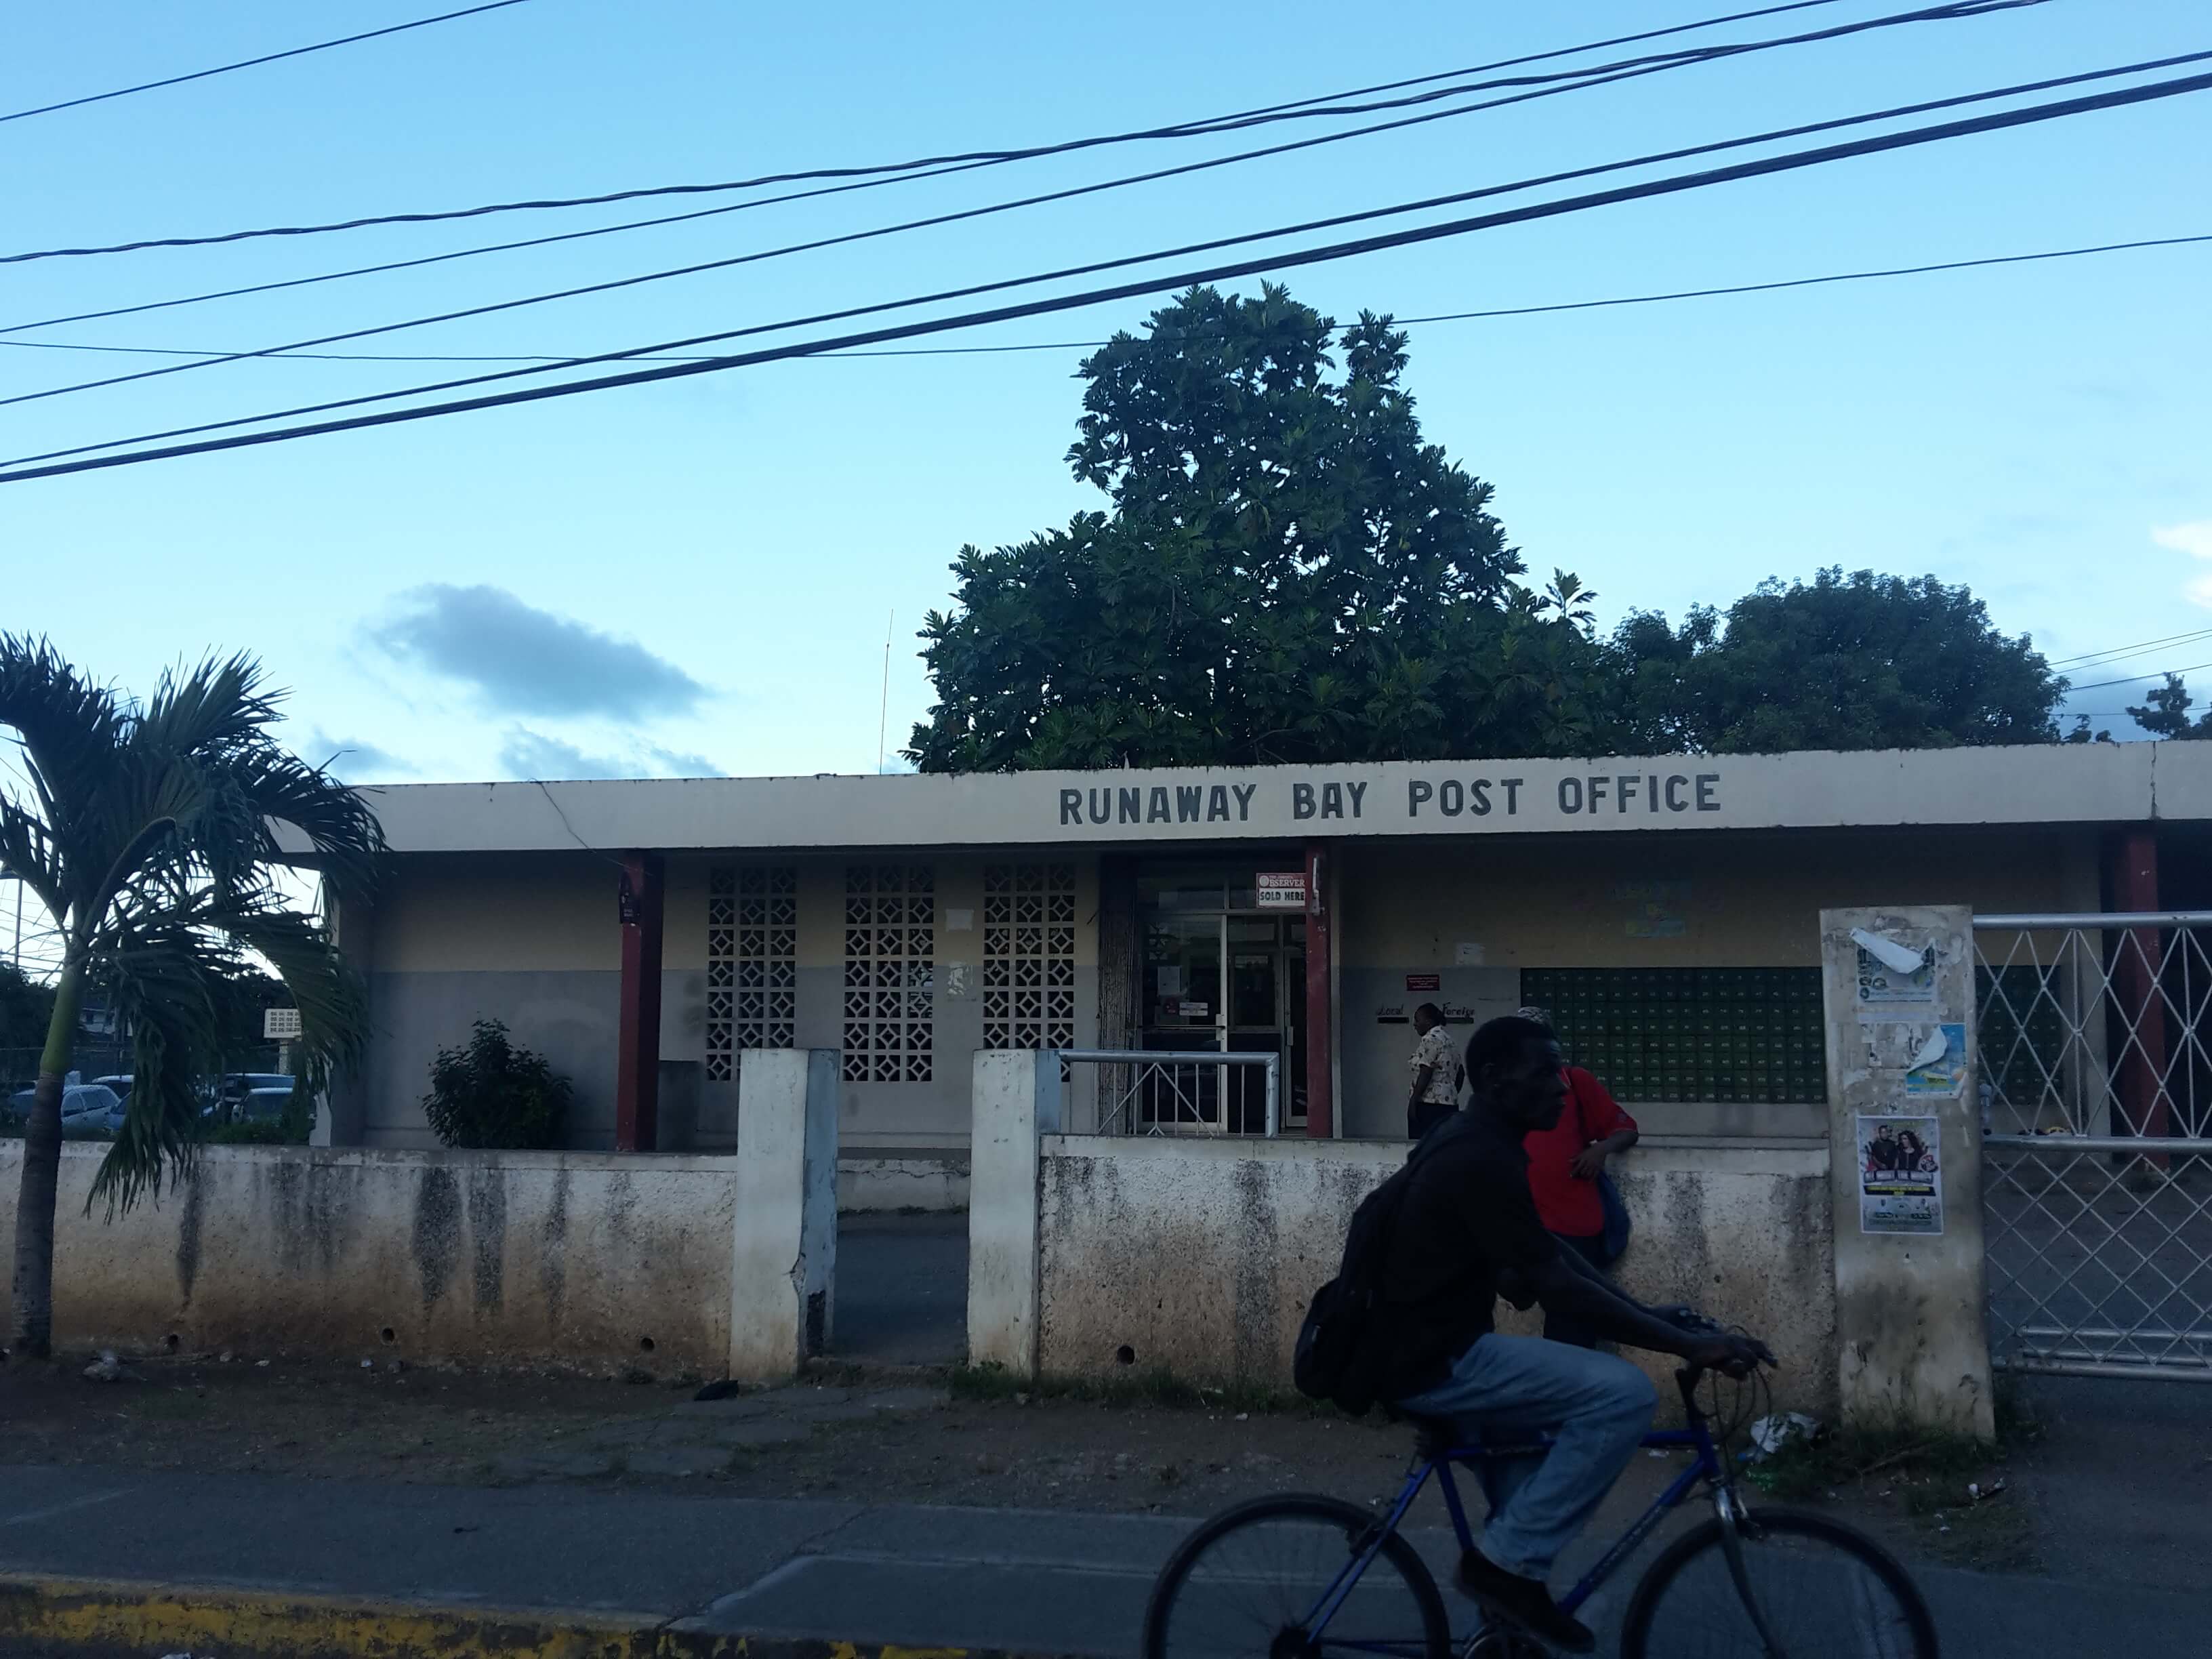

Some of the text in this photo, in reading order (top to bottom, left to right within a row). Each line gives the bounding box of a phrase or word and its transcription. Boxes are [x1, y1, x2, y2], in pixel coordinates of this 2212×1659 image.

[1060, 771, 1721, 826] RUNAWAY BAY POST OFFICE
[1260, 891, 1305, 901] SOLD HERE
